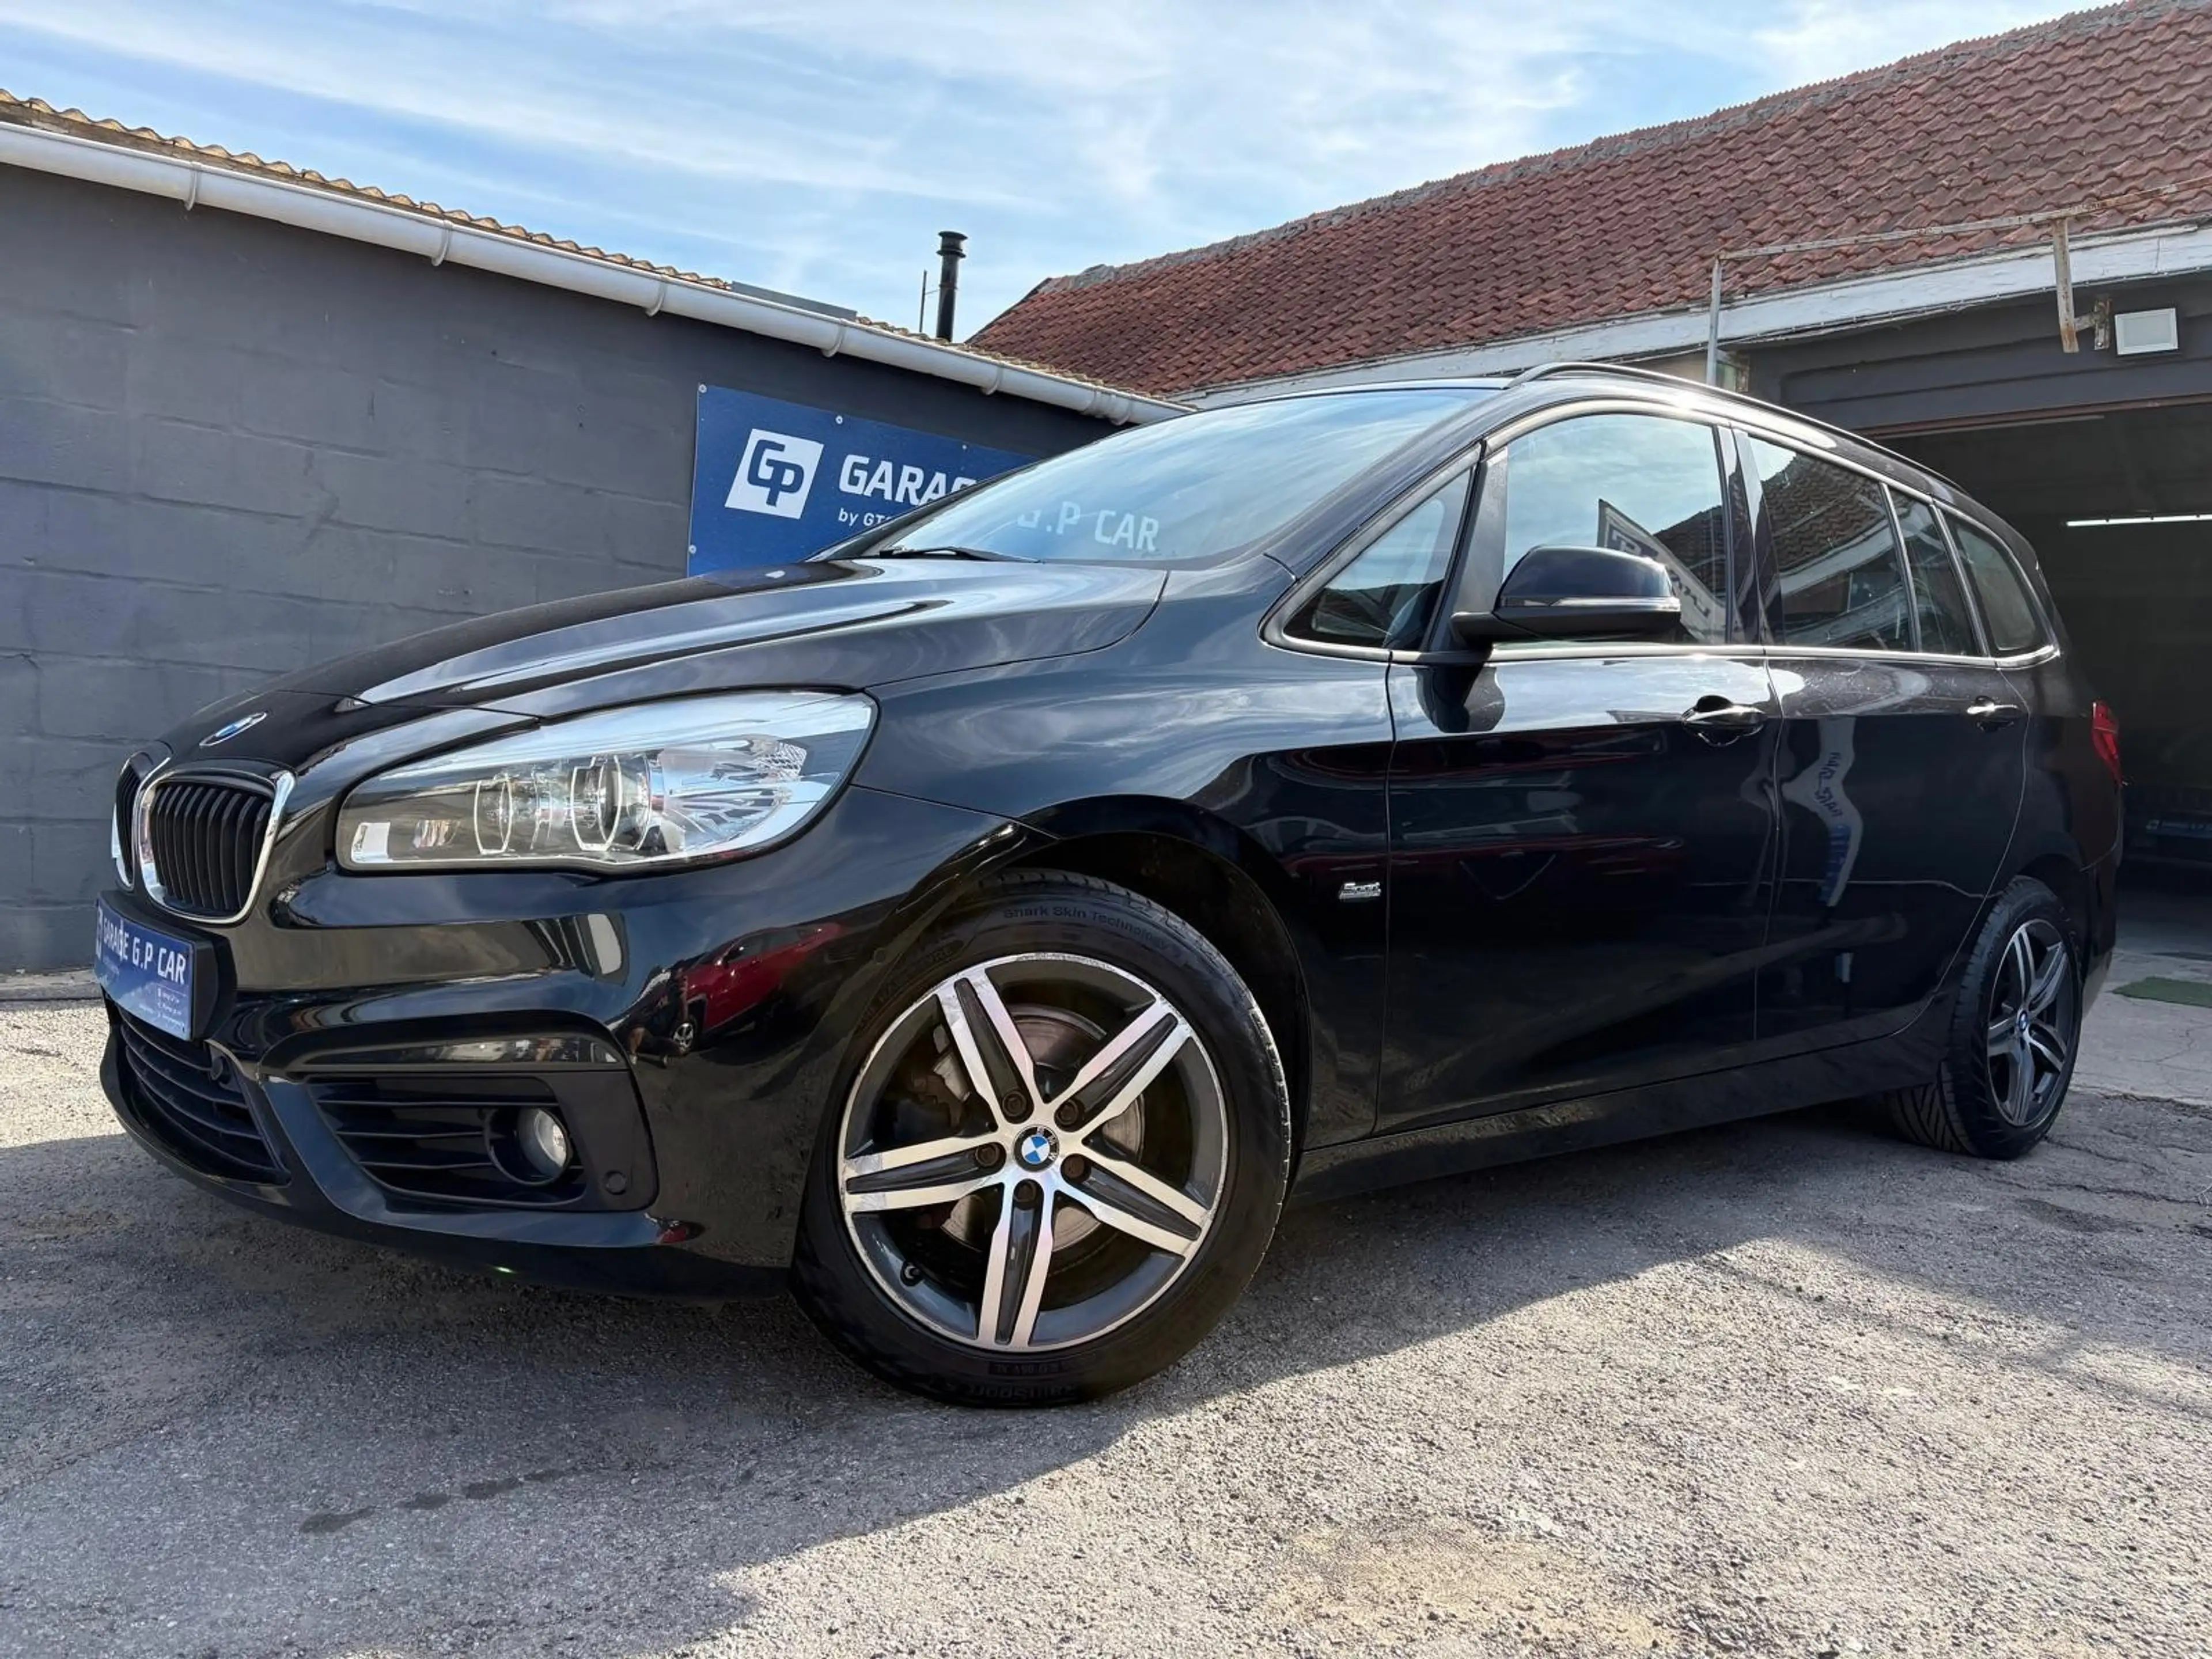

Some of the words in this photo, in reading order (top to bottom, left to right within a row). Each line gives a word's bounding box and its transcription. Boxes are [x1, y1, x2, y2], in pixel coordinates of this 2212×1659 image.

[838, 507, 859, 527] by
[1094, 509, 1159, 552] CAR
[1052, 906, 1086, 919] Skin
[132, 936, 154, 971] G.P
[157, 947, 187, 985] CAR
